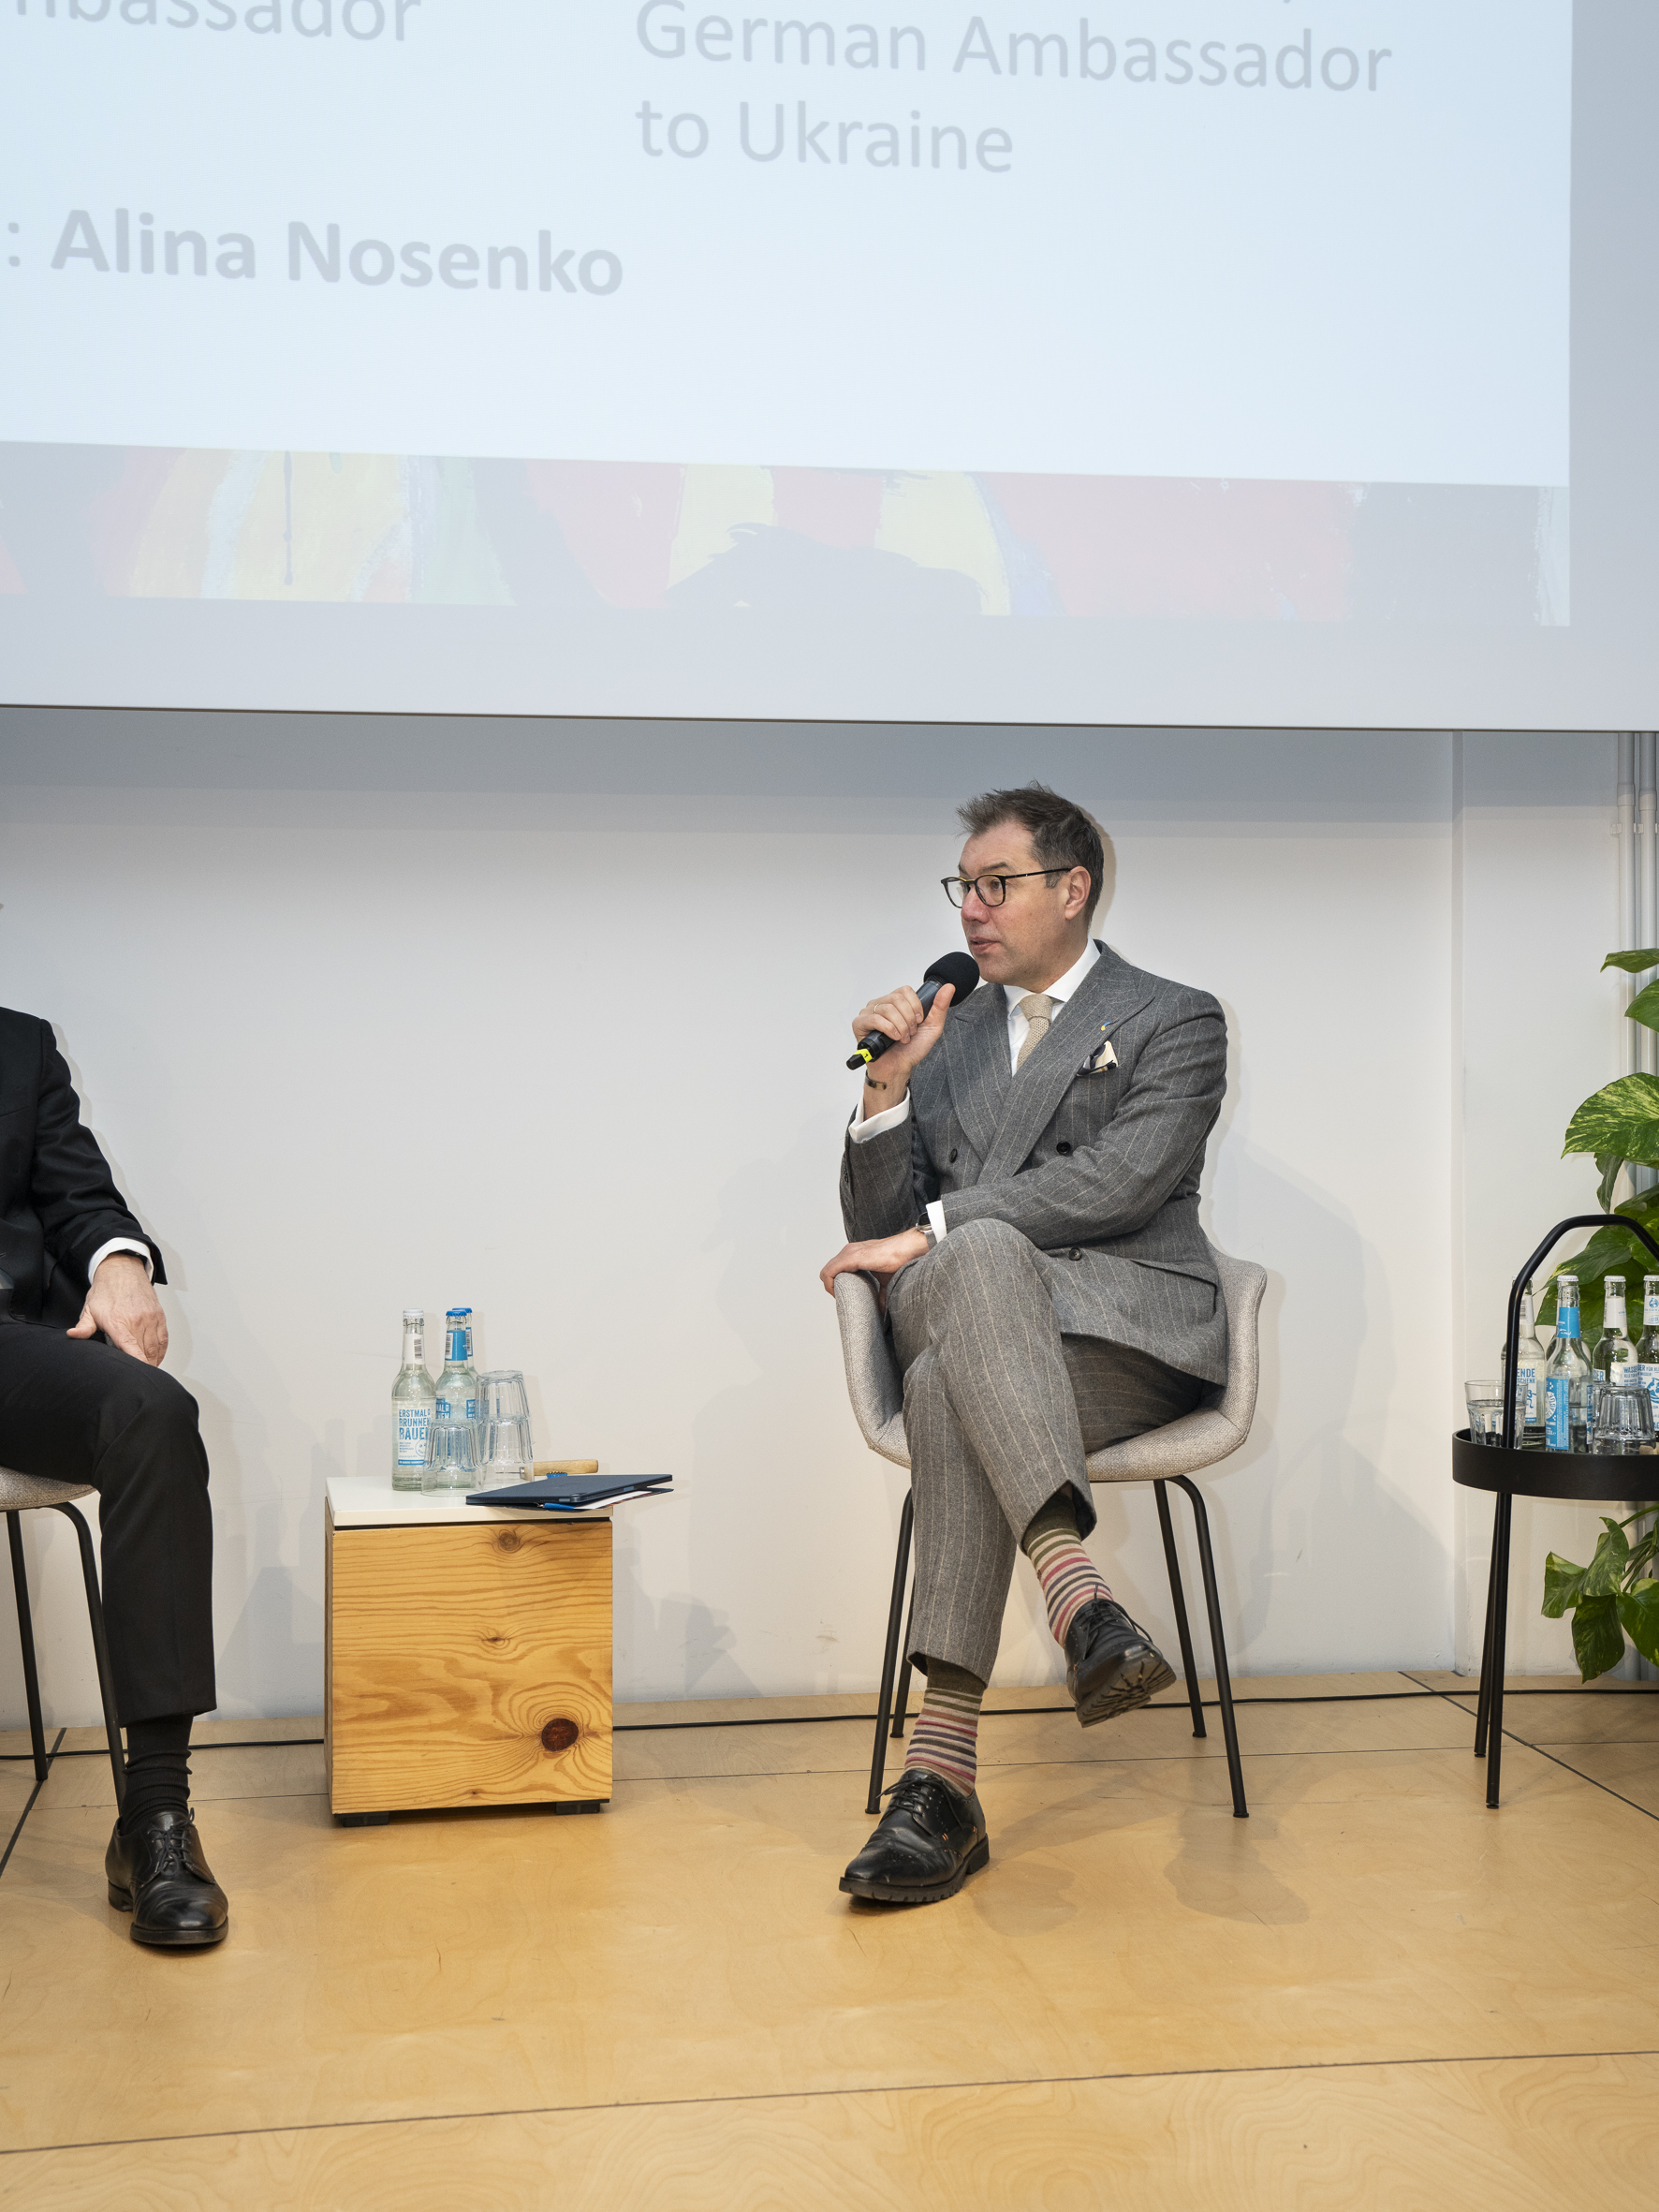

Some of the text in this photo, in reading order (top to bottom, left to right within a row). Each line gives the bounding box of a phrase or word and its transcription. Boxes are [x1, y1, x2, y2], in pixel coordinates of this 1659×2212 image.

[635, 0, 1392, 93] German Ambassador
[635, 99, 1014, 173] to Ukraine
[51, 207, 257, 280] Alina
[287, 220, 624, 296] Nosenko
[399, 1408, 427, 1418] ERSTMAL
